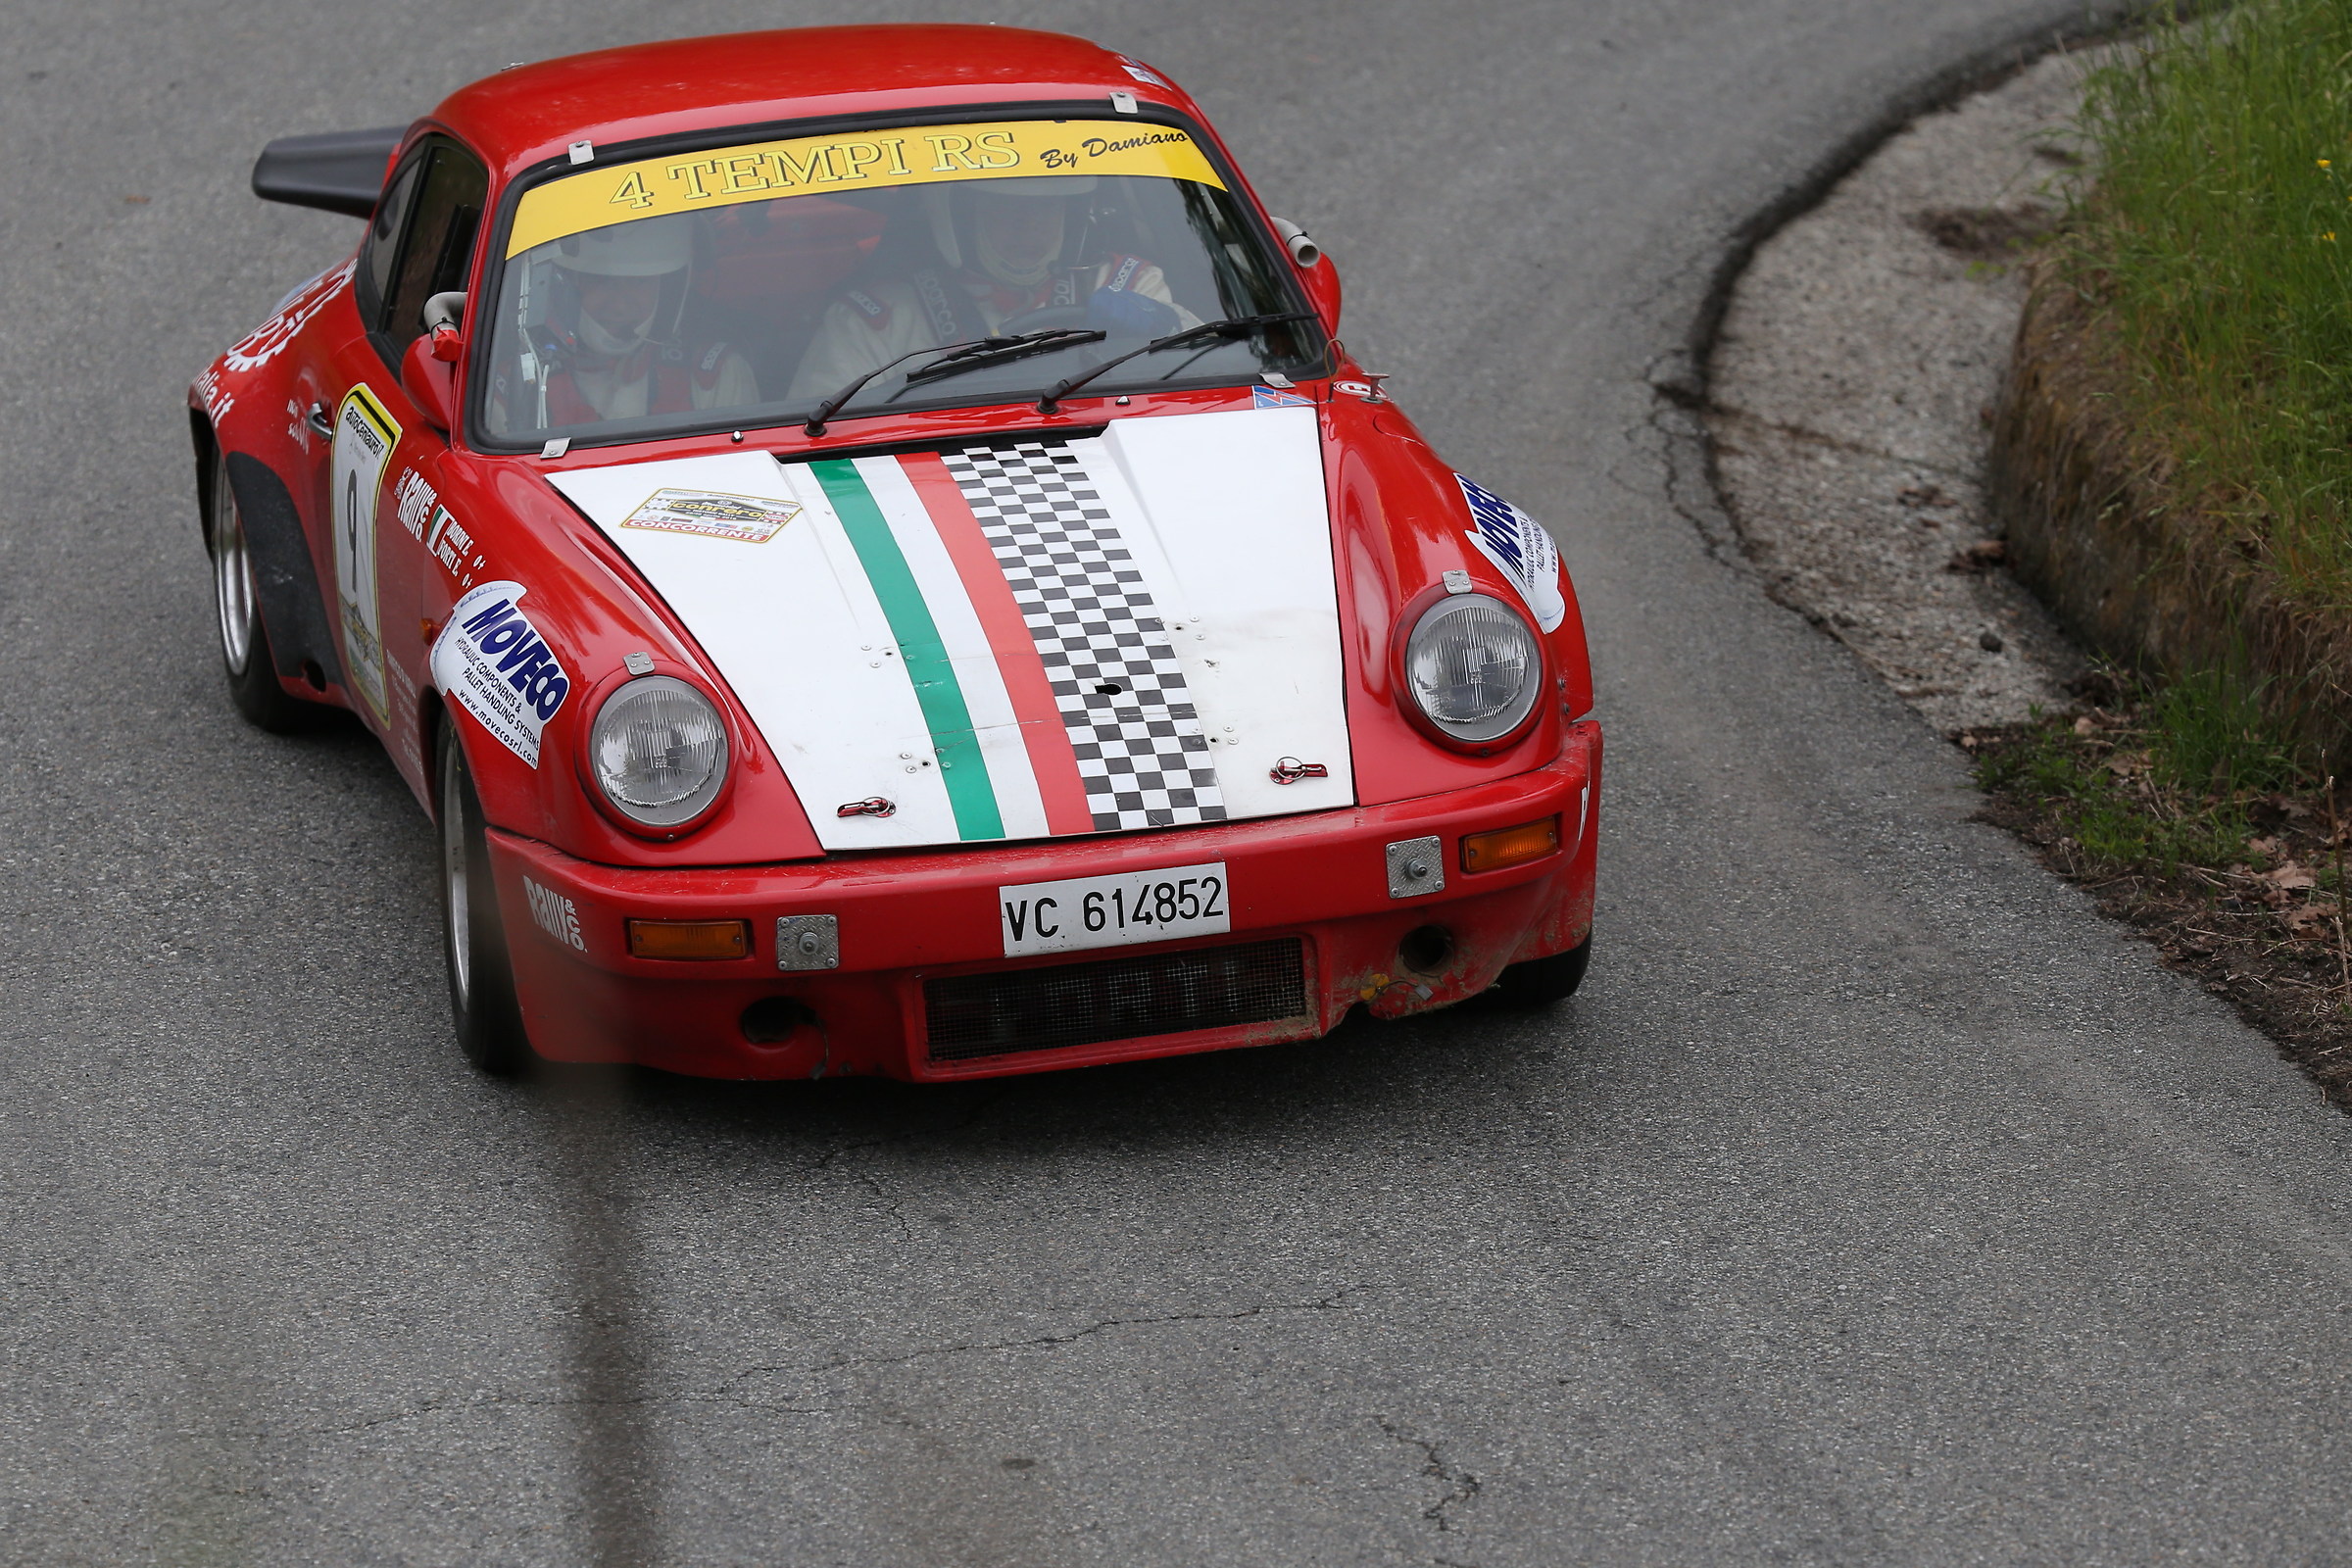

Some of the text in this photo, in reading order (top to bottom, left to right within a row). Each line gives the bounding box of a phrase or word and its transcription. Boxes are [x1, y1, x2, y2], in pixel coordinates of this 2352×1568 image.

[609, 131, 1020, 209] 4 TEMPI RS
[1040, 132, 1188, 169] By Damiano
[347, 468, 358, 593] 9
[629, 519, 763, 541] CONCORRENTE
[672, 503, 762, 517] conrero
[454, 637, 521, 713] HYDRAULIC COMPONENTS &
[462, 599, 568, 720] MOVECO
[459, 689, 538, 767] www.movecosrl.com
[462, 667, 539, 751] PALLET HANDLING SYSTEMS
[1004, 876, 1224, 942] VC 614852
